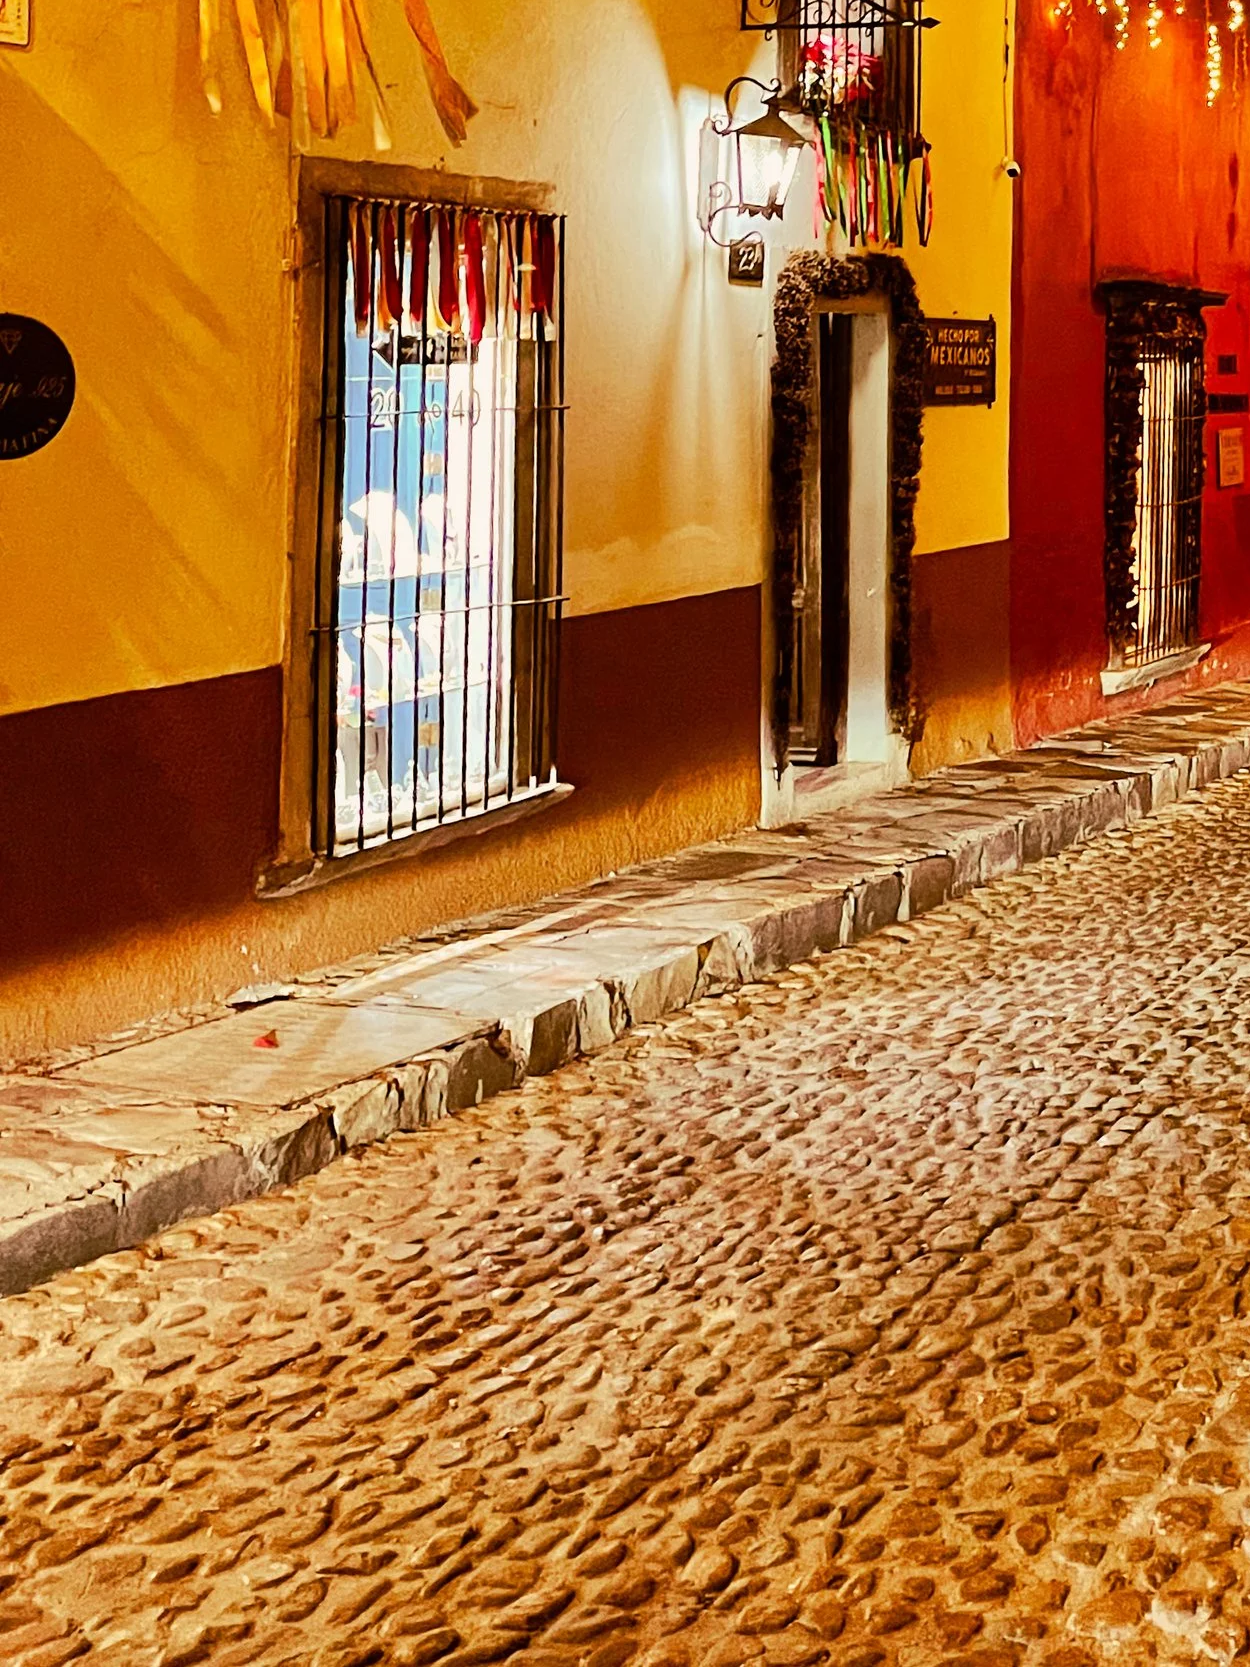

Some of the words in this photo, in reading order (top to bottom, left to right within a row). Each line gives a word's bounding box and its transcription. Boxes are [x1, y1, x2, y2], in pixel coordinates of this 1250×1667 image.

[937, 328, 964, 343] HECHO
[964, 328, 980, 343] POR
[930, 345, 991, 366] MEXICANOS
